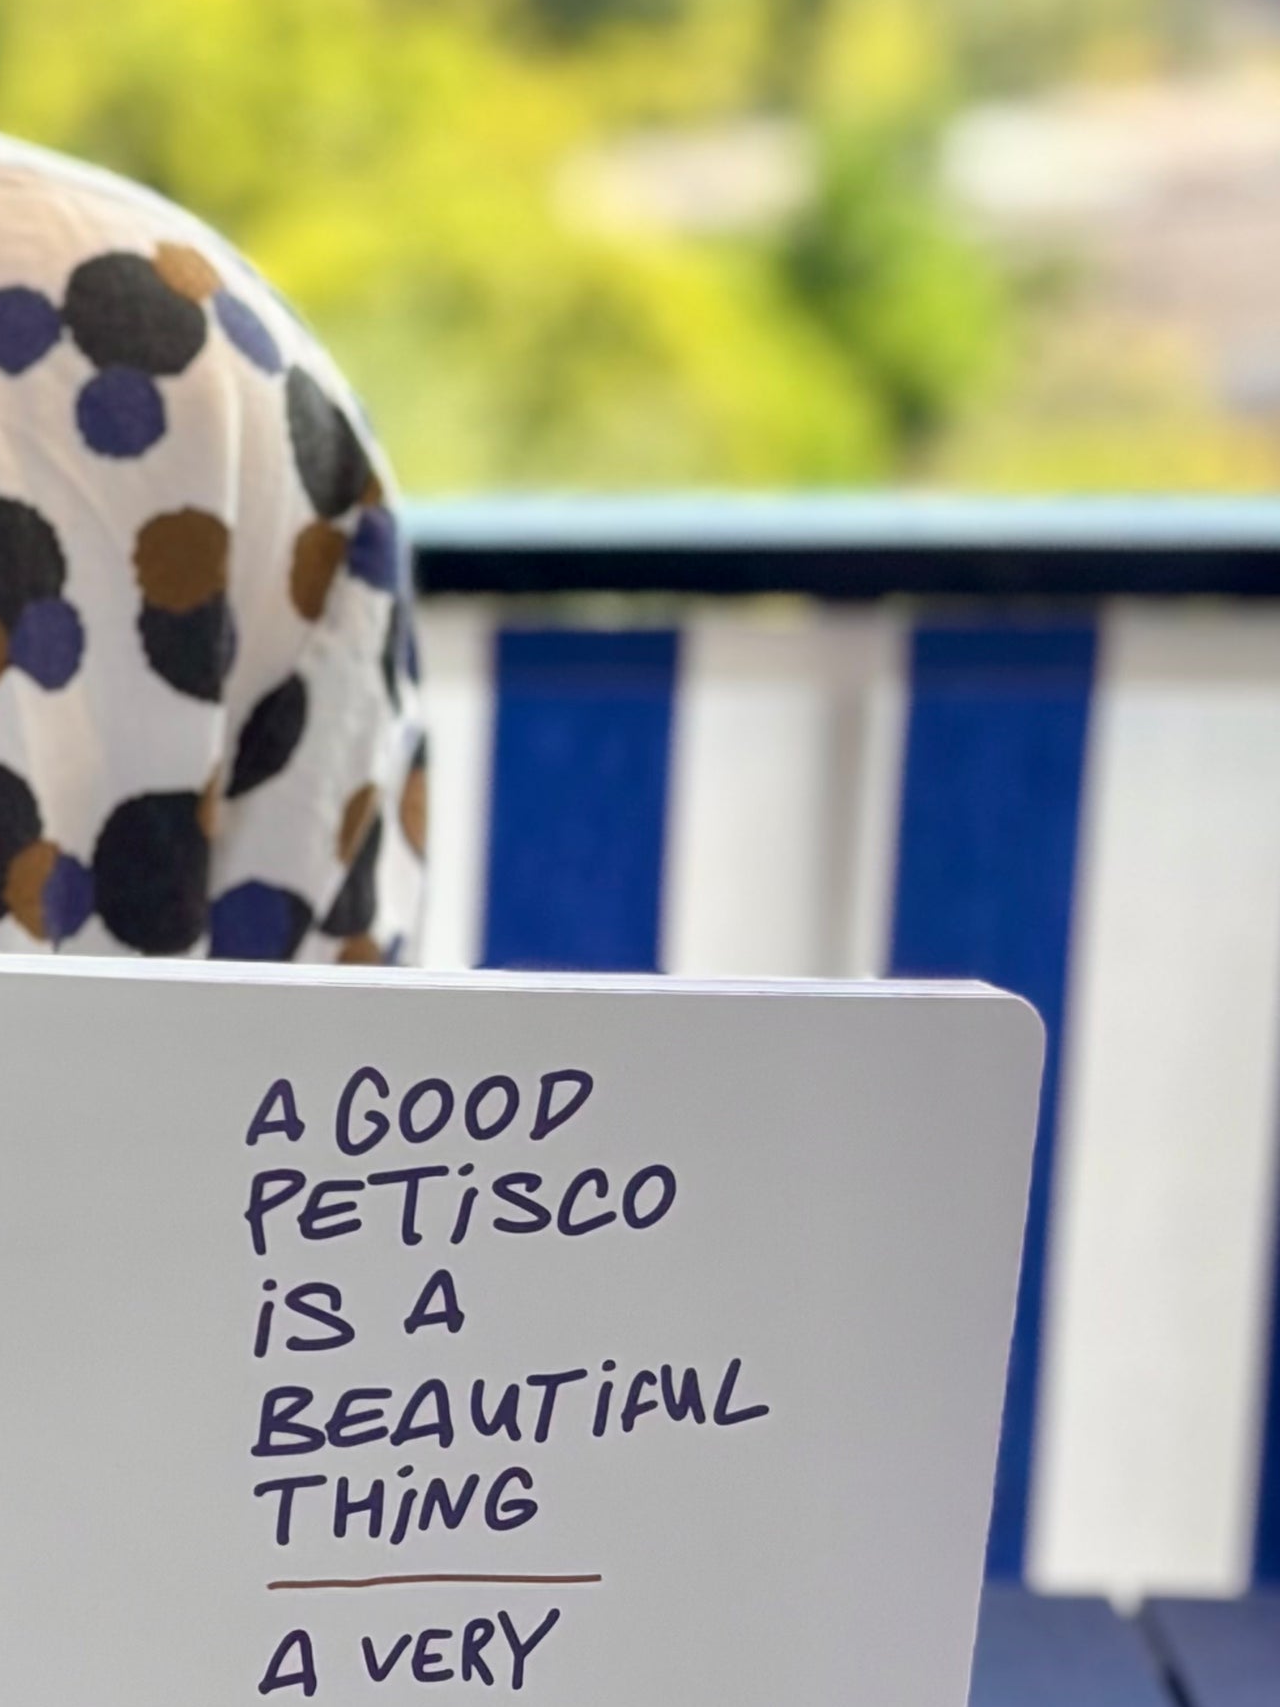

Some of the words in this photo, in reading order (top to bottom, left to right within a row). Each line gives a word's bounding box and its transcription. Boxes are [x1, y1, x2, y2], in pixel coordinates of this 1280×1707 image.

[246, 1079, 305, 1146] A
[336, 1066, 593, 1156] GOOD
[404, 1269, 465, 1334] A
[258, 1629, 317, 1697] A
[361, 1608, 560, 1690] VERY
